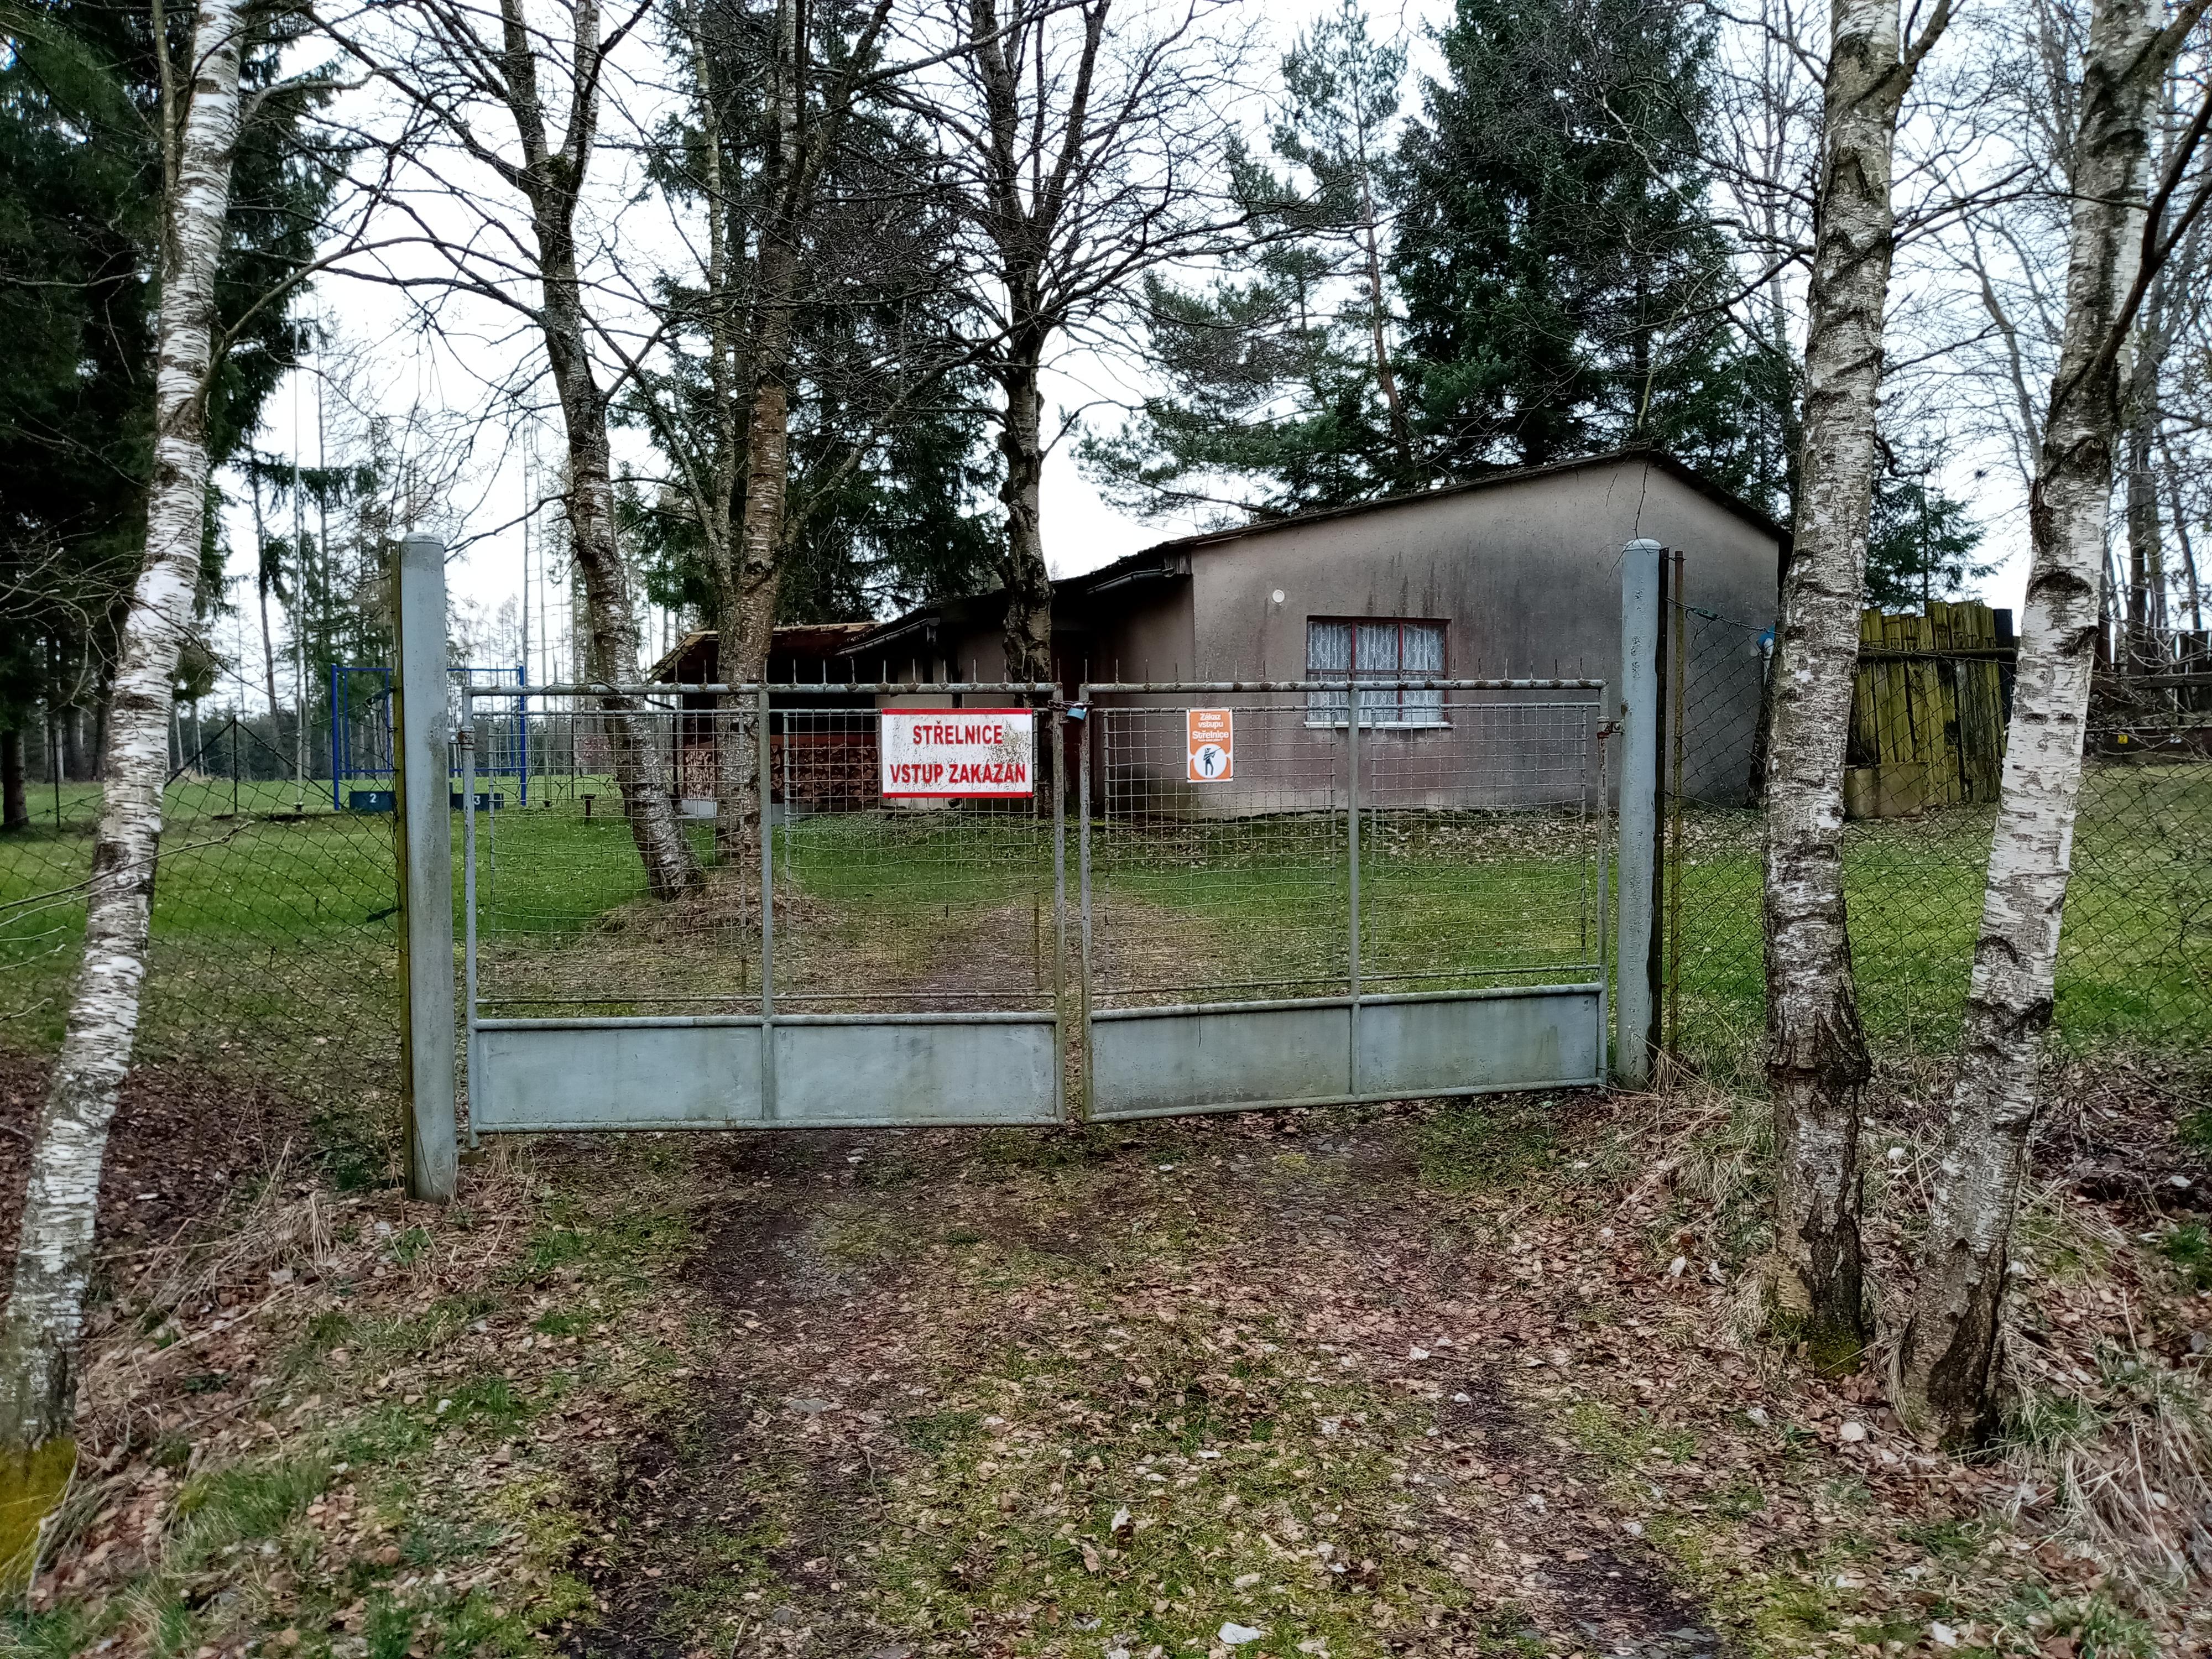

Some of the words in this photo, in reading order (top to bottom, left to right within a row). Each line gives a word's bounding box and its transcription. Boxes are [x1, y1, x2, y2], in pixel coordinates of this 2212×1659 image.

[1198, 721, 1224, 729] vstupu
[912, 720, 1003, 745] STŘELNICE
[1192, 730, 1229, 740] Střelnice
[890, 764, 943, 784] VSTUP
[369, 793, 377, 803] 2
[473, 795, 481, 805] 3
